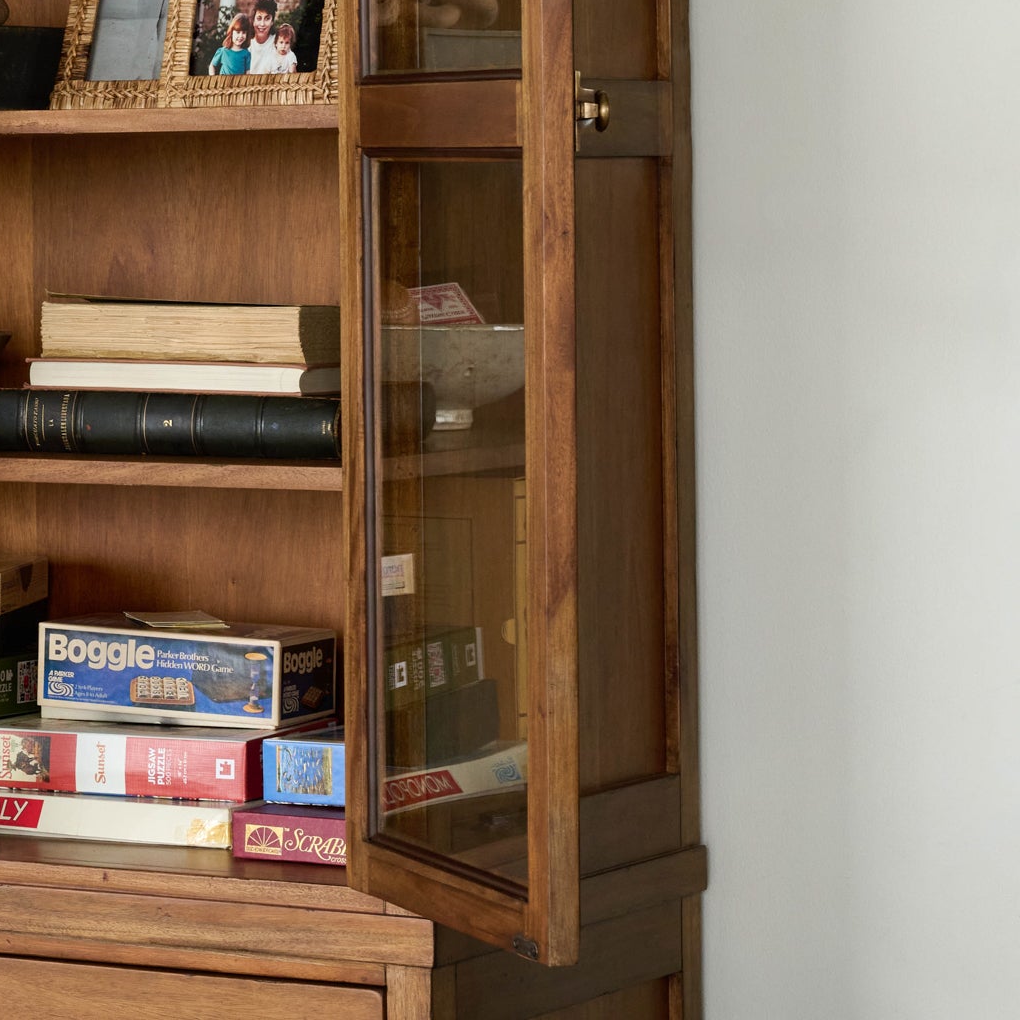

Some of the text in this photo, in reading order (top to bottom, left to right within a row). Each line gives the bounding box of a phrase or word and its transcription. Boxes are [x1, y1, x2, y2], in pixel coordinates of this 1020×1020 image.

[163, 419, 173, 427] 2
[48, 633, 155, 671] Boggle
[156, 659, 234, 674] Hidden WORD Game
[157, 649, 209, 662] Parker Brothers
[283, 646, 323, 675] Boggle
[0, 736, 13, 780] Sunset
[94, 741, 107, 784] Sunset
[147, 747, 156, 785] JIGSAW
[157, 747, 166, 785] PUZZLE
